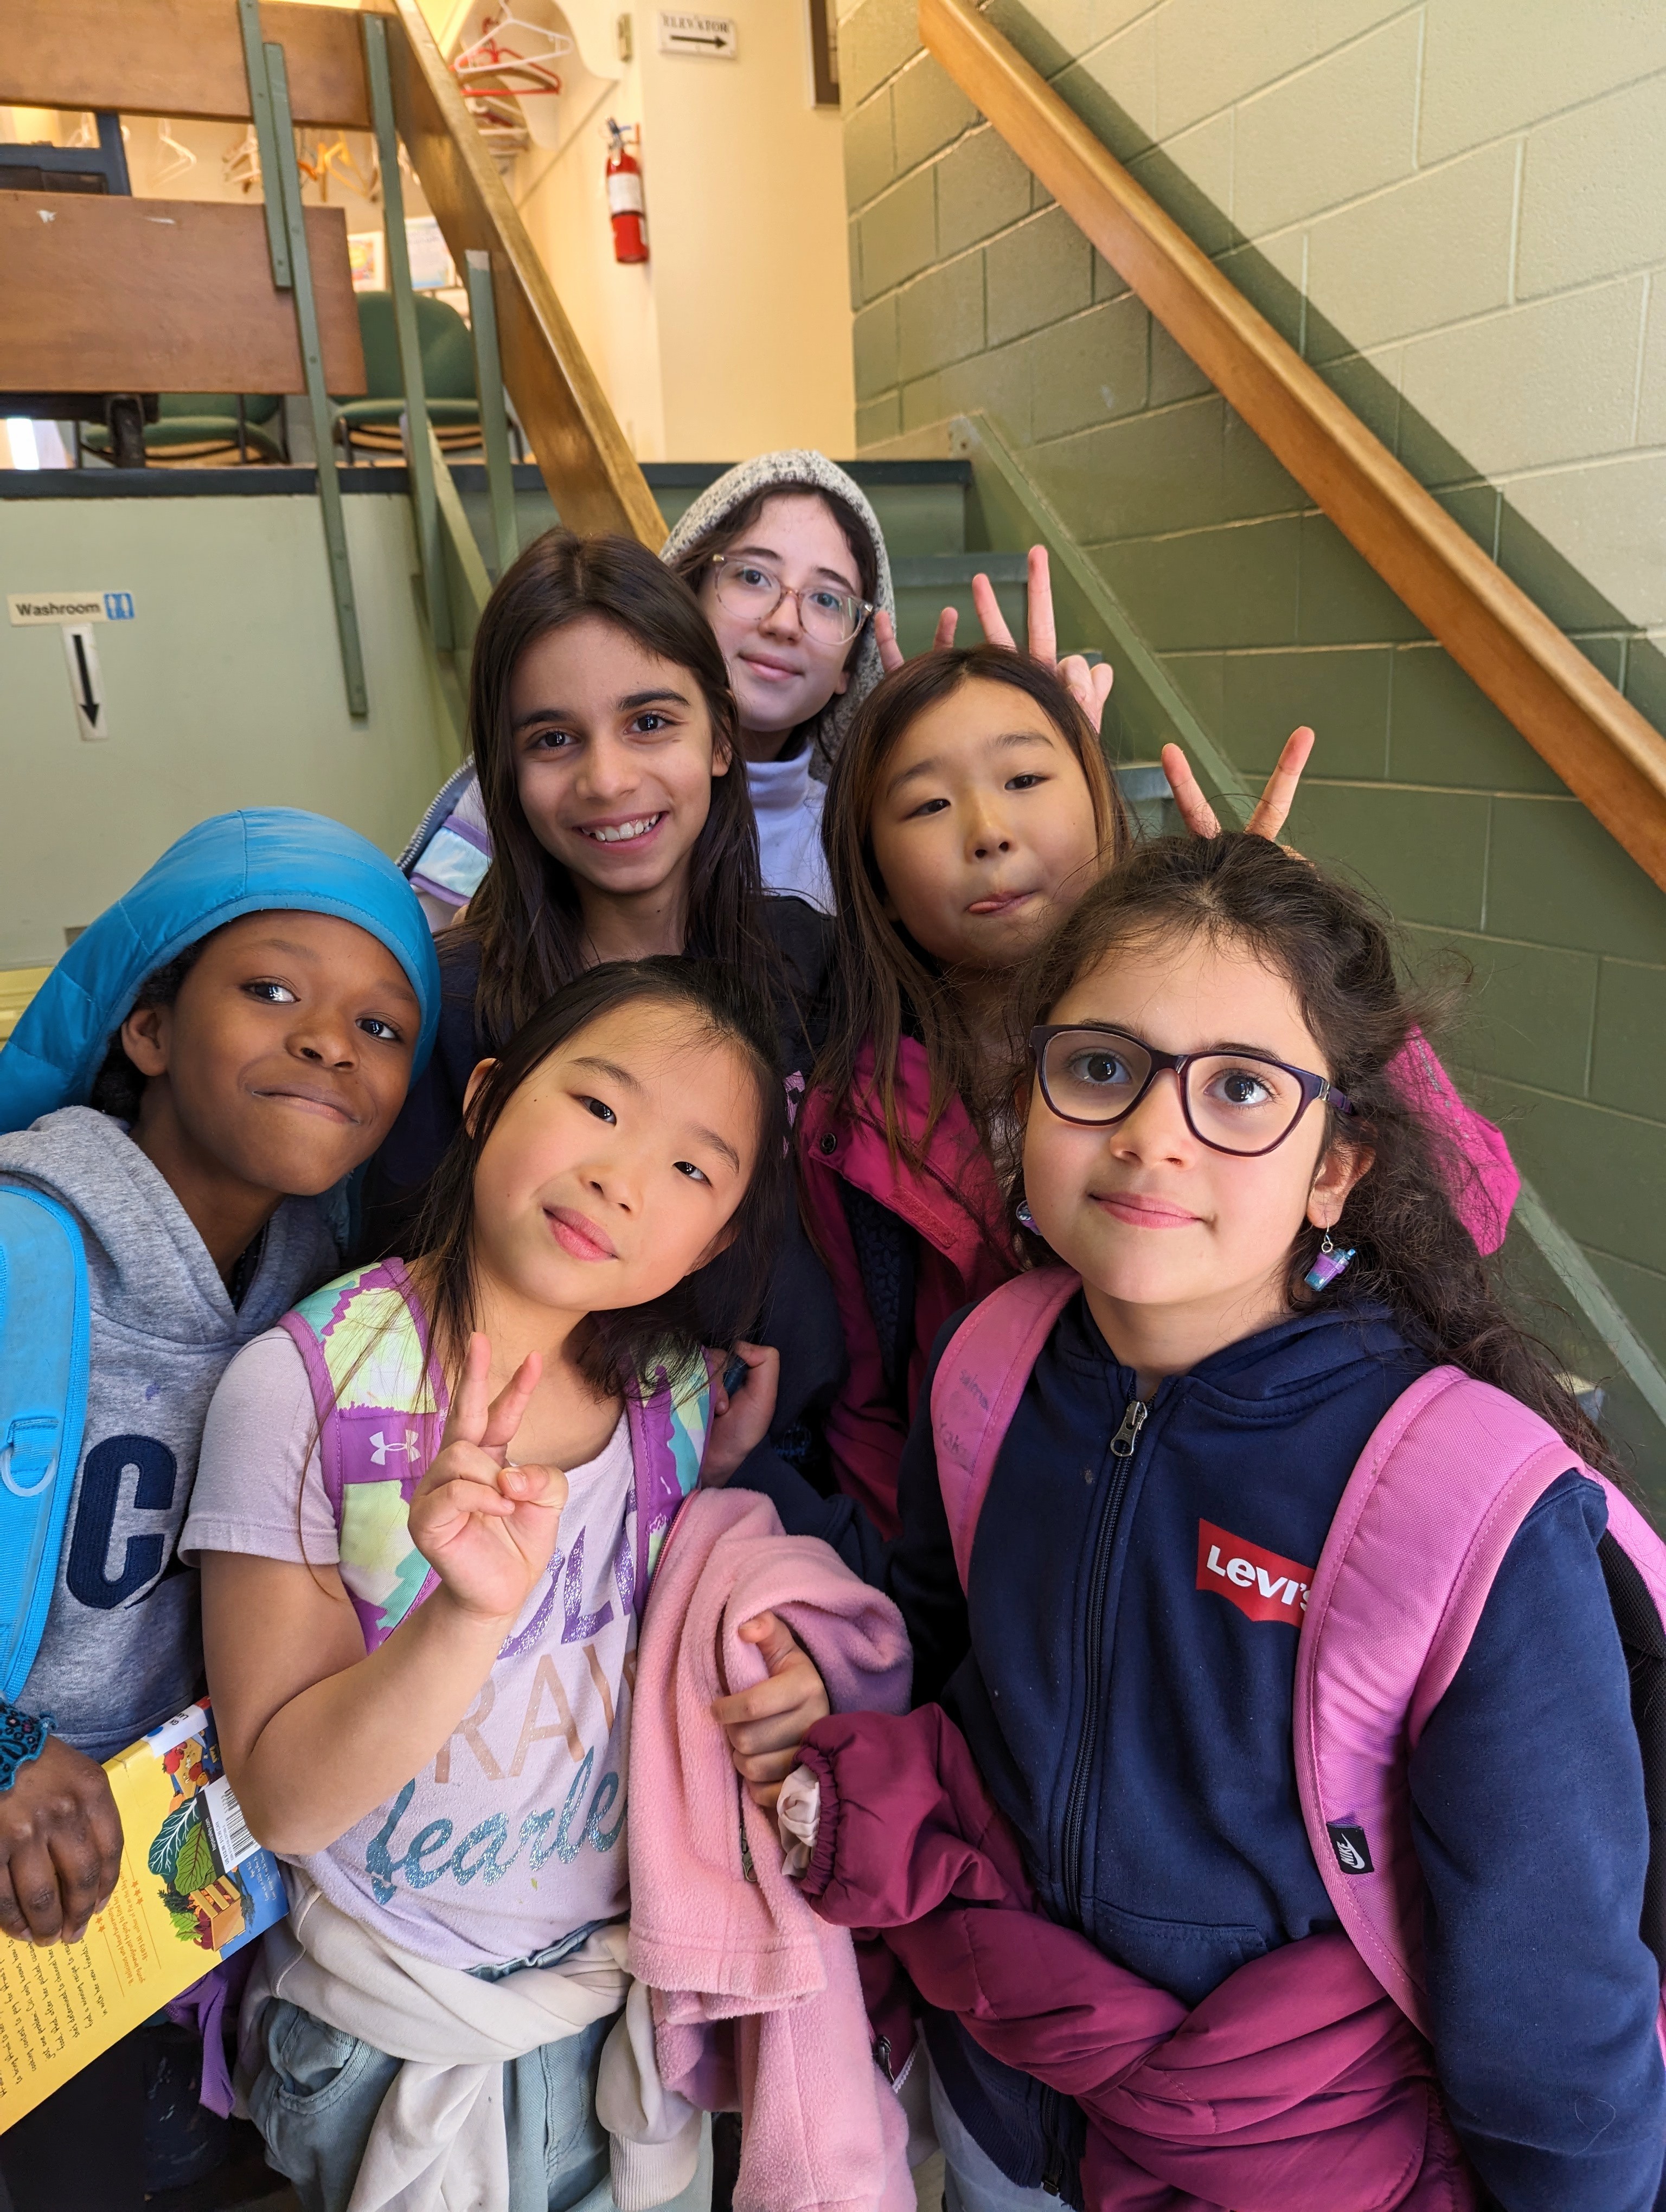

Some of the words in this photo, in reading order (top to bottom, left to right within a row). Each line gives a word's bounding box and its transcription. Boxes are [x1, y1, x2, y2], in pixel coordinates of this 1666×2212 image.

[662, 15, 730, 34] ELEVATOR
[15, 602, 101, 616] Washroom
[67, 1434, 177, 1610] C
[1336, 1841, 1355, 1866] NIKE
[108, 1907, 123, 1947] heartwarming
[122, 1921, 131, 1940] trying
[27, 1940, 37, 1962] cucumb
[81, 1944, 92, 1970] friends,
[118, 1946, 126, 1956] and
[125, 1939, 139, 1969] immigrant
[67, 1957, 74, 1965] to
[123, 1956, 132, 1979] delicious
[16, 1963, 25, 1984] knows
[49, 1959, 62, 1983] channel
[71, 1966, 80, 1982] recipe
[136, 1967, 145, 1983] young
[21, 1982, 31, 1996] only
[58, 1983, 65, 1991] to
[77, 1982, 87, 2007] winning
[4, 1992, 13, 2004] for
[26, 1997, 35, 2011] Cici
[96, 1995, 105, 2009] with
[12, 2002, 21, 2015] pay
[45, 2001, 55, 2016] after
[59, 1990, 75, 2024] determined
[102, 2009, 107, 2017] in
[15, 2017, 22, 2026] to
[49, 2016, 60, 2034] And
[84, 2012, 93, 2028] find
[2, 2034, 9, 2043] to
[17, 2026, 29, 2048] contest
[69, 2023, 80, 2038] she's
[27, 2048, 36, 2072] cooking
[42, 2047, 56, 2061] just
[16, 2075, 23, 2085] to
